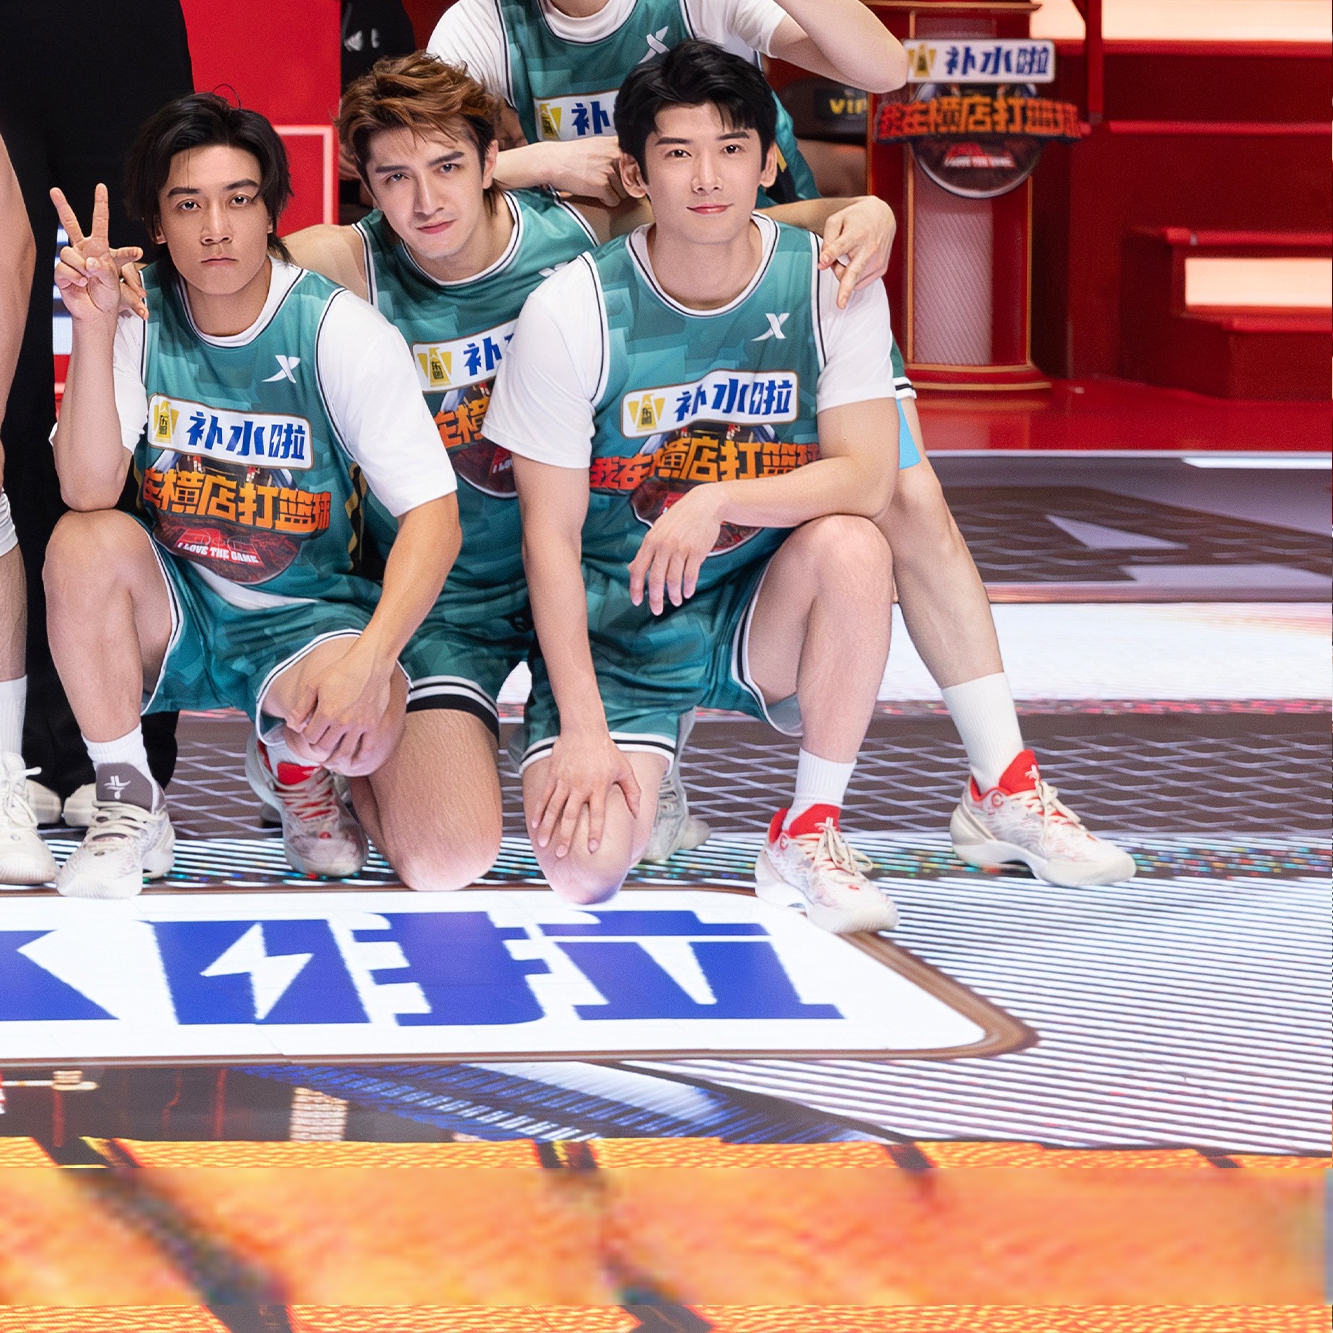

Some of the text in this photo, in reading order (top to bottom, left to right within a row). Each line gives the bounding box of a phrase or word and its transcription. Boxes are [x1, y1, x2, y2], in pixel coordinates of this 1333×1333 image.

[944, 44, 1051, 77] 补水啦
[674, 378, 794, 423] 补水啦
[186, 411, 307, 461] 补水啦
[183, 543, 209, 557] LOVE
[209, 547, 230, 560] THE
[230, 550, 260, 564] GAME
